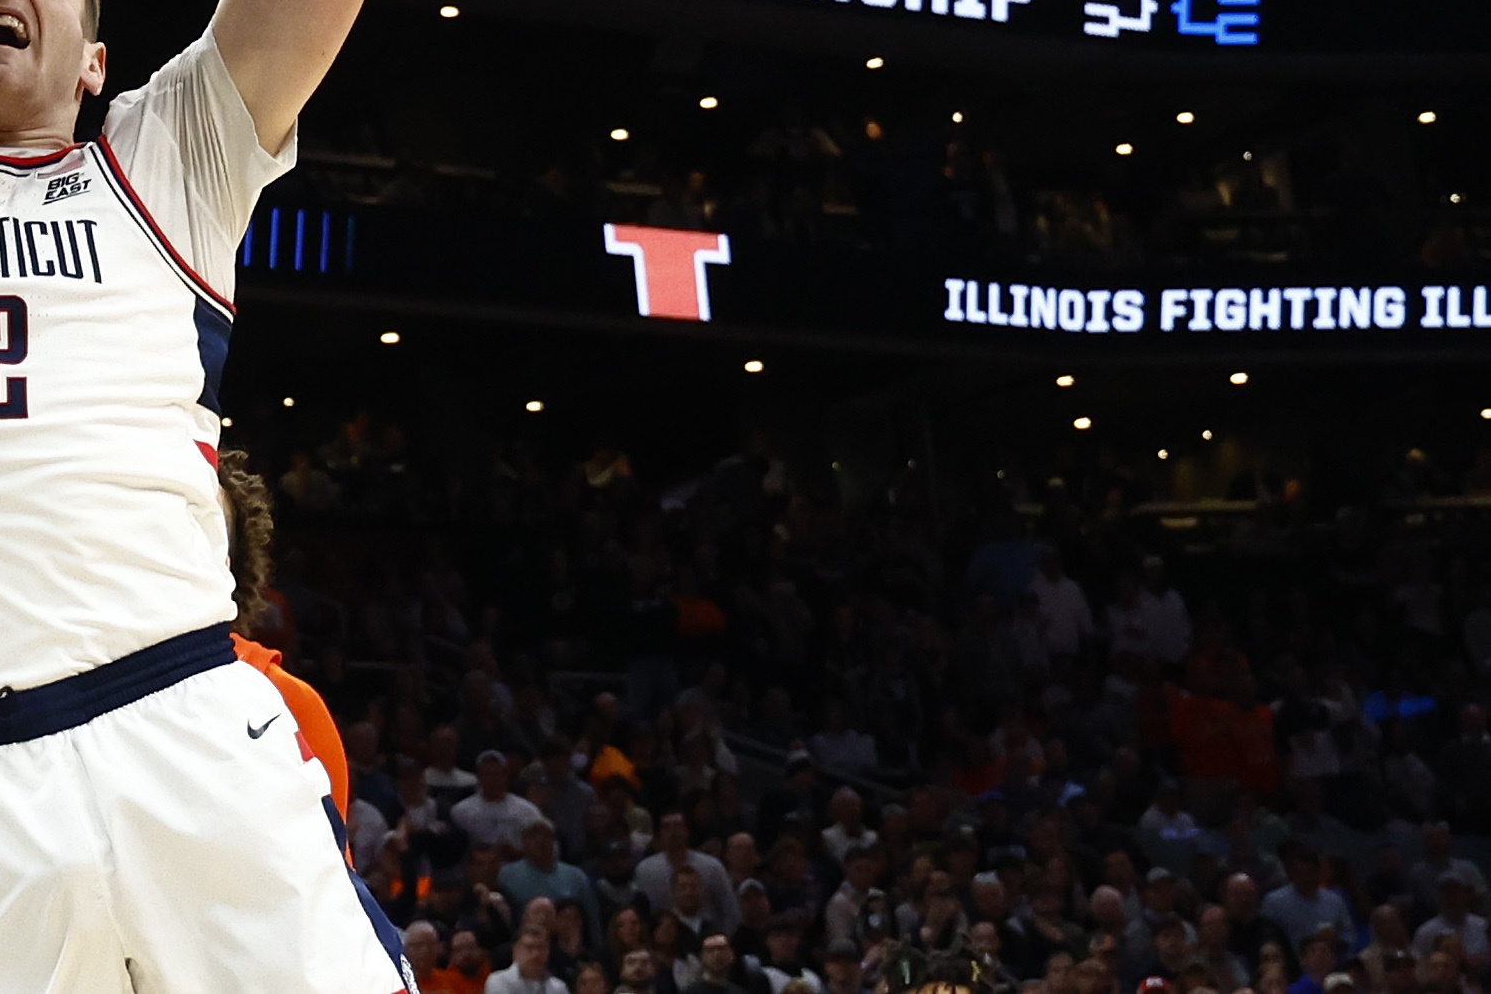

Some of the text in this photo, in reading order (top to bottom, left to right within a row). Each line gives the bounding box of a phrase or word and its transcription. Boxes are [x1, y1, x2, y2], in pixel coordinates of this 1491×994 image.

[44, 178, 92, 200] EAST
[47, 172, 80, 190] BIG
[943, 278, 1145, 333] ILLINOIS
[1160, 286, 1406, 332] FIGHTING
